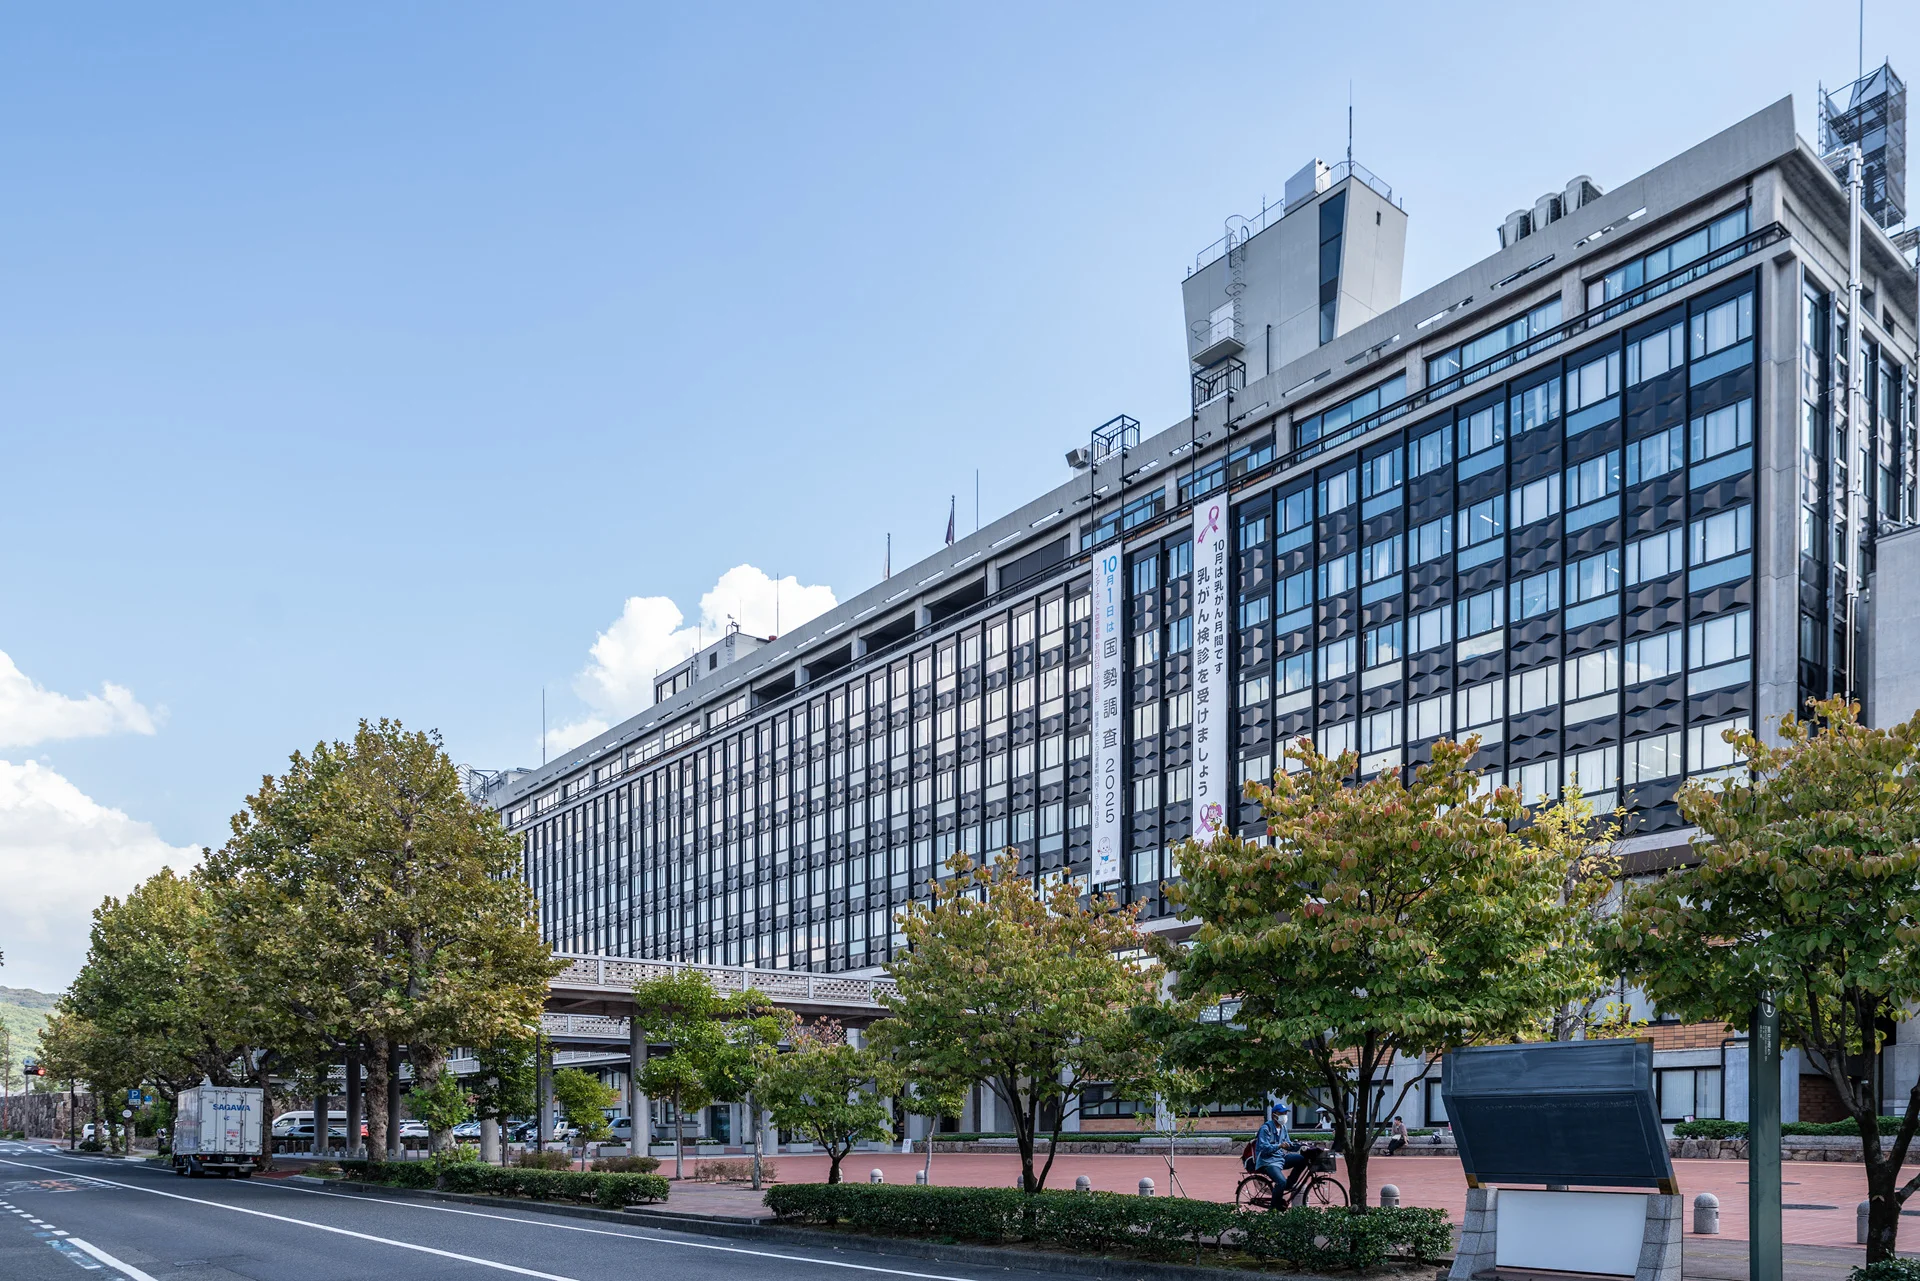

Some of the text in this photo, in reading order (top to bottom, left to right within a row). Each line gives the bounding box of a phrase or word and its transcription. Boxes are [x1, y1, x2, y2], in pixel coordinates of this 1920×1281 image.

[1213, 539, 1224, 674] 10月は乳がん月間です
[1197, 566, 1210, 797] 乳がん検診を受けましょう
[131, 1090, 139, 1099] P
[212, 1103, 251, 1111] SAGAWA
